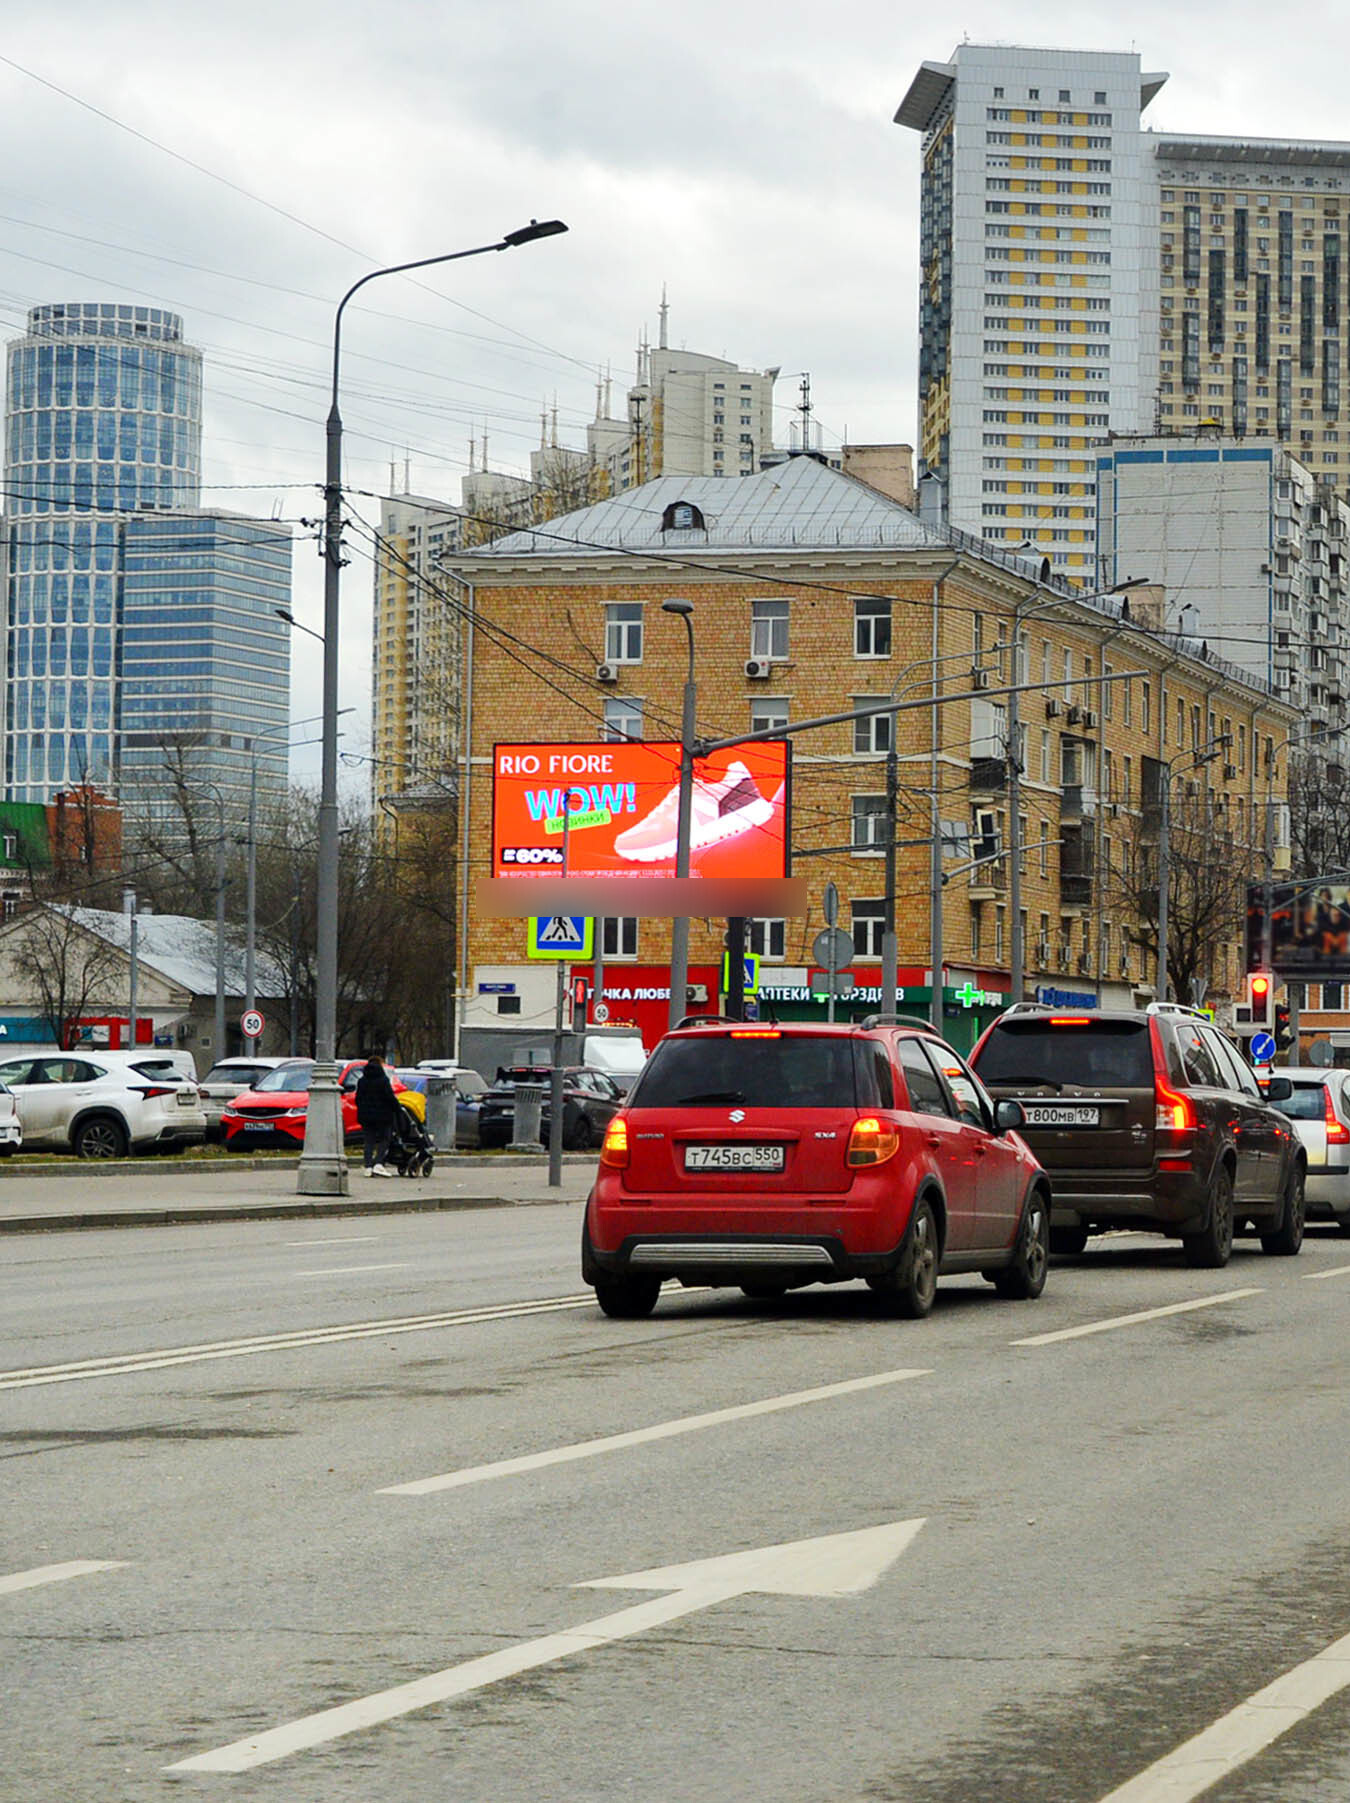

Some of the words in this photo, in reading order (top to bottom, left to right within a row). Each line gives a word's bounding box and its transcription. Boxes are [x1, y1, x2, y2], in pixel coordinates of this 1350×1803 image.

[500, 756, 540, 774] RIO
[549, 755, 613, 773] FIORE
[525, 783, 637, 821] WOW!
[586, 988, 632, 999] ТЧКА
[758, 987, 810, 1001] АПТЕКИ
[833, 987, 904, 1003] РЗДРВ
[246, 1018, 260, 1030] 50
[1026, 1109, 1074, 1122] Т800МВ
[691, 1149, 752, 1165] Т745ВС
[755, 1148, 780, 1161] 550
